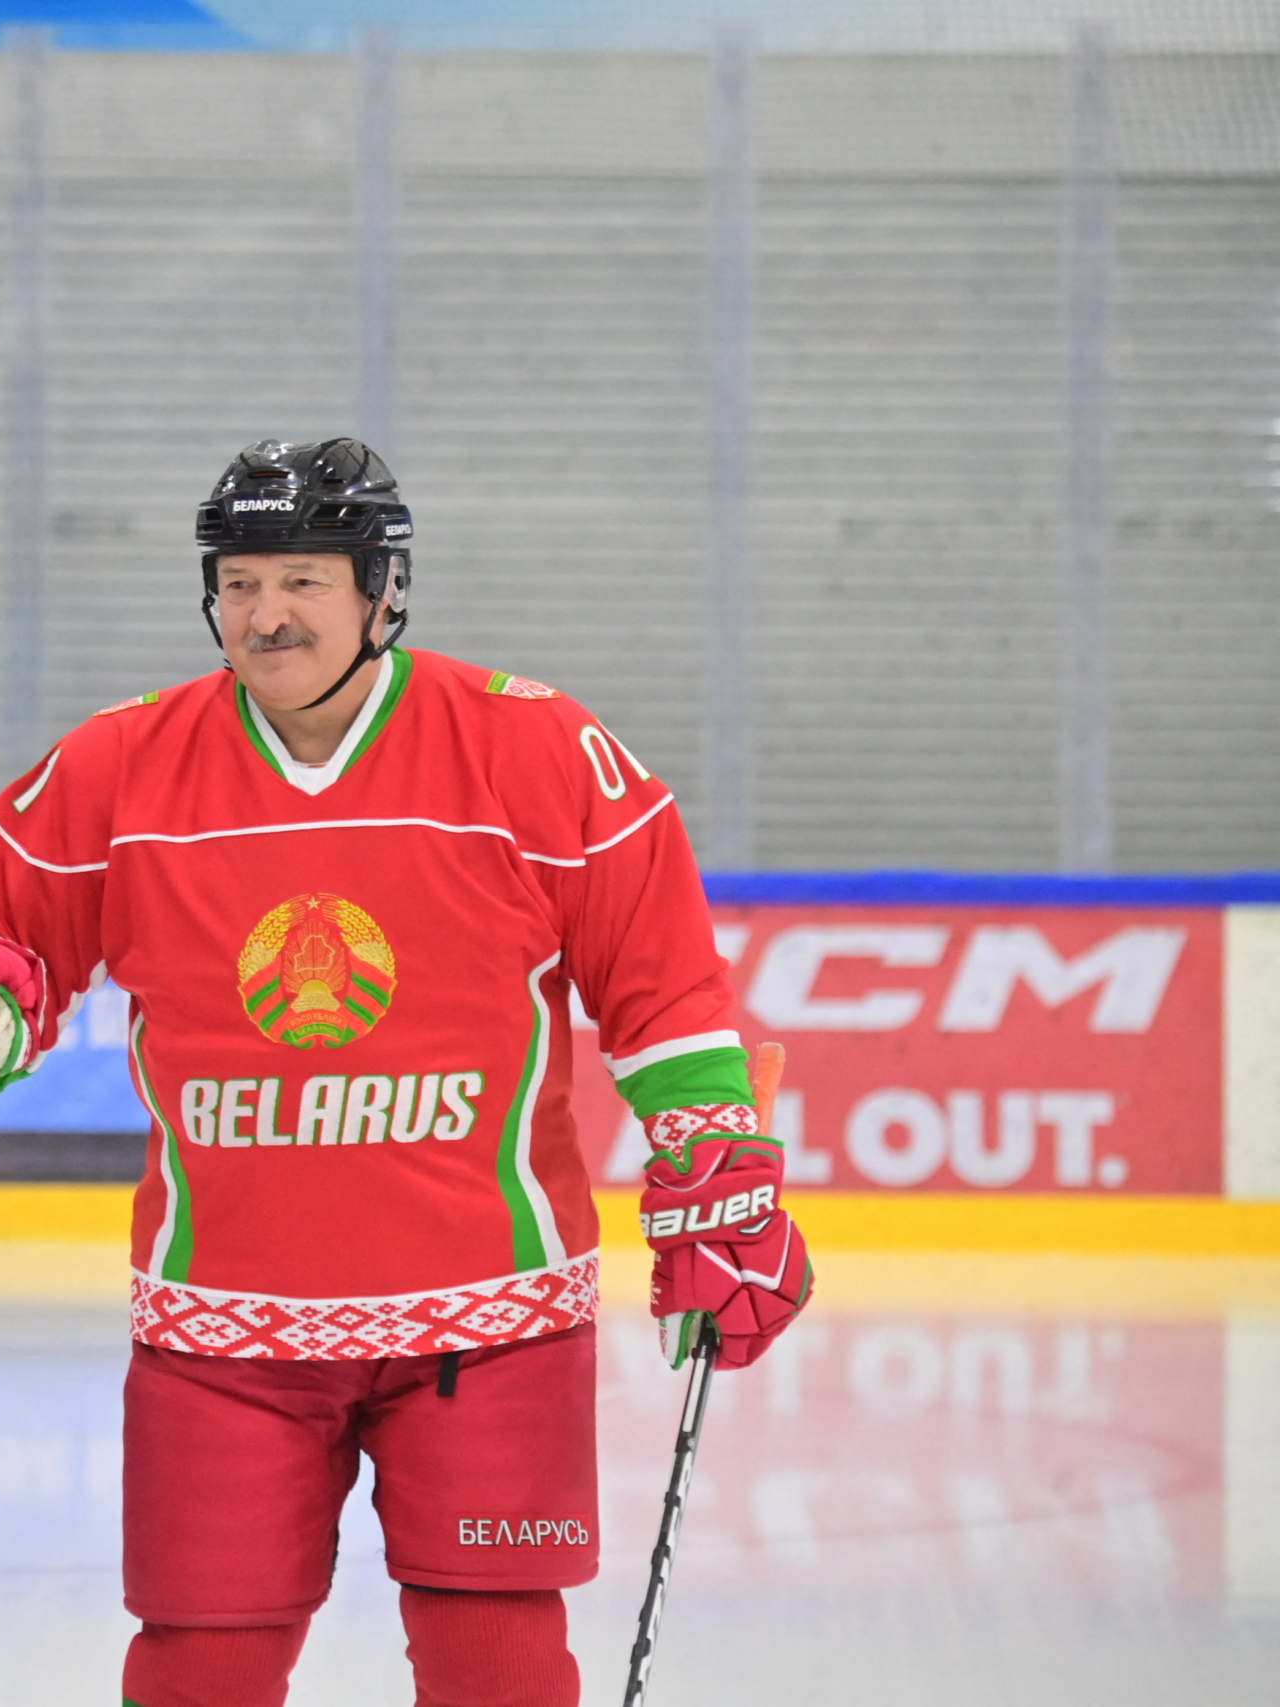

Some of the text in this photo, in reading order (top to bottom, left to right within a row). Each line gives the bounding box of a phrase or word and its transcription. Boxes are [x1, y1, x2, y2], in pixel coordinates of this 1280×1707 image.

[233, 499, 295, 513] БЕЛАРУСЬ
[714, 924, 1189, 1034] CM
[180, 1070, 485, 1148] BELARUS
[844, 1087, 1129, 1188] OUT.
[638, 1184, 775, 1239] BAUER
[458, 1518, 589, 1546] БЕЛАРУСЬ
